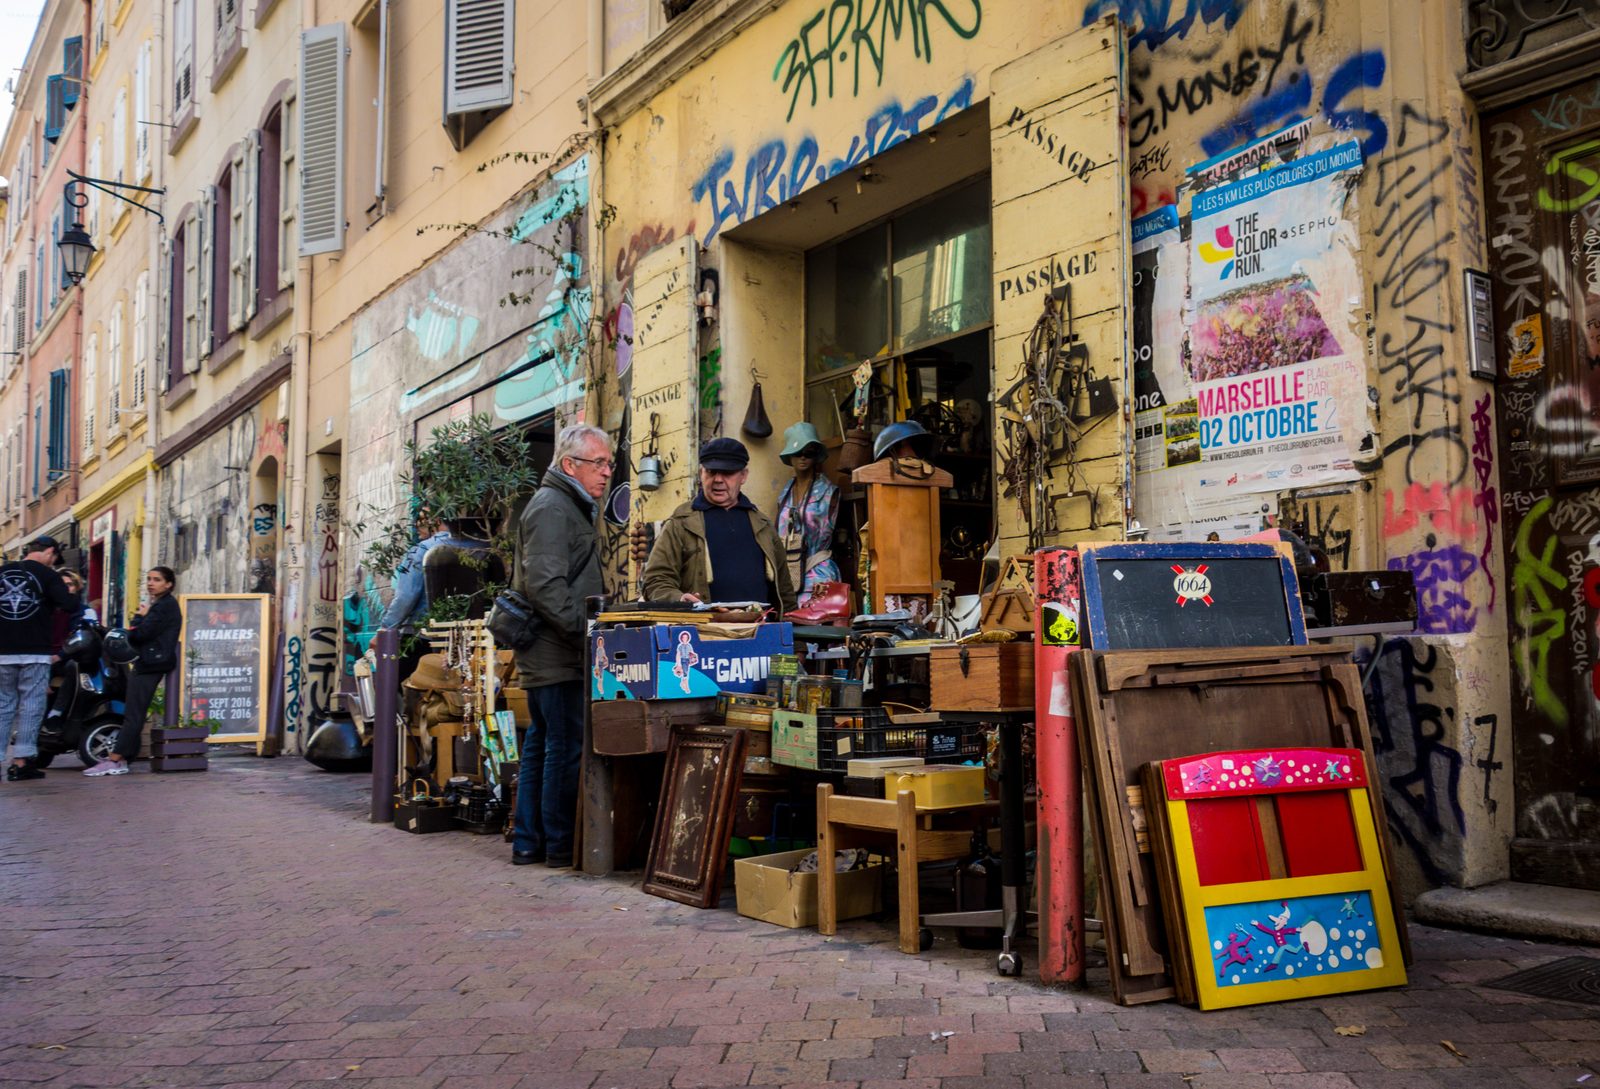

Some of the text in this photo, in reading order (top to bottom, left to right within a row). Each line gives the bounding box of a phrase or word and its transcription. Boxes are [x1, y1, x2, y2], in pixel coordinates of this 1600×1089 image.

[1006, 106, 1096, 184] PASSAGE
[1202, 195, 1217, 212] LES
[1218, 196, 1224, 207] 5
[1225, 188, 1239, 204] KM
[1238, 184, 1254, 200] LES
[1255, 176, 1276, 194] PLUS
[1316, 159, 1328, 173] DU
[1329, 147, 1361, 168] MONDE
[1235, 212, 1259, 236] THE
[1235, 228, 1277, 258] COLOR
[1000, 250, 1097, 301] PASSAGE
[638, 268, 681, 346] PASSAGE
[636, 383, 681, 412] PASSAGE
[1199, 370, 1305, 418] MARSEILLE
[1200, 419, 1223, 449] 02
[1229, 401, 1318, 445] OCTOBRE
[1177, 576, 1208, 592] 1664
[193, 628, 254, 641] SNEAKERS
[192, 666, 253, 677] SNEAKER'S
[610, 662, 650, 683] LE GAMIN
[701, 657, 715, 670] LE
[208, 697, 230, 708] SEPT
[231, 697, 252, 708] 2016
[209, 709, 227, 719] DEC
[231, 709, 252, 719] 2016
